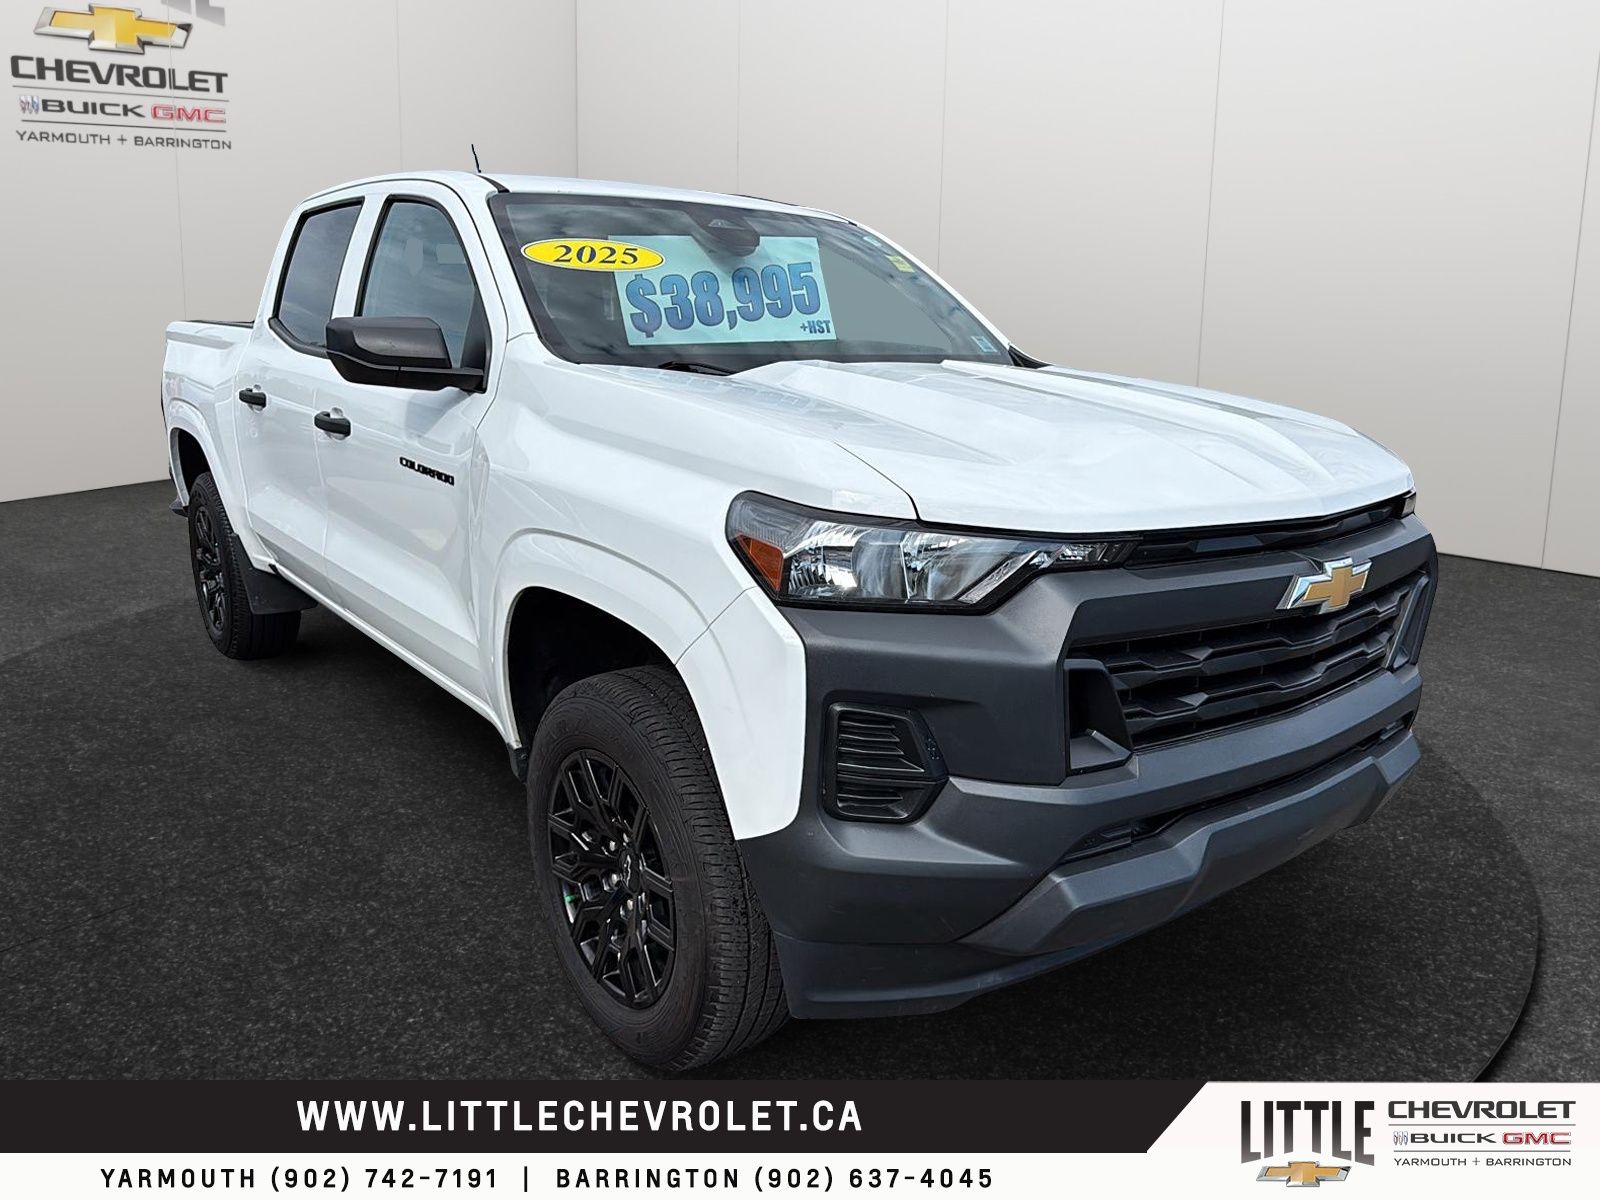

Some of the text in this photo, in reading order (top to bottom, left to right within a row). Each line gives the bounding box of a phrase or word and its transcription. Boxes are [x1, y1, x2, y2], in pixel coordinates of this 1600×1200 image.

[10, 55, 228, 94] CHEVROLET
[41, 98, 227, 124] BUICK GMC
[16, 130, 111, 145] YARMOUTH
[134, 136, 232, 150] BARRINGTON
[553, 244, 639, 265] 2025
[625, 262, 821, 338] $38,995
[800, 319, 832, 335] +HST
[399, 456, 455, 486] COLORADO
